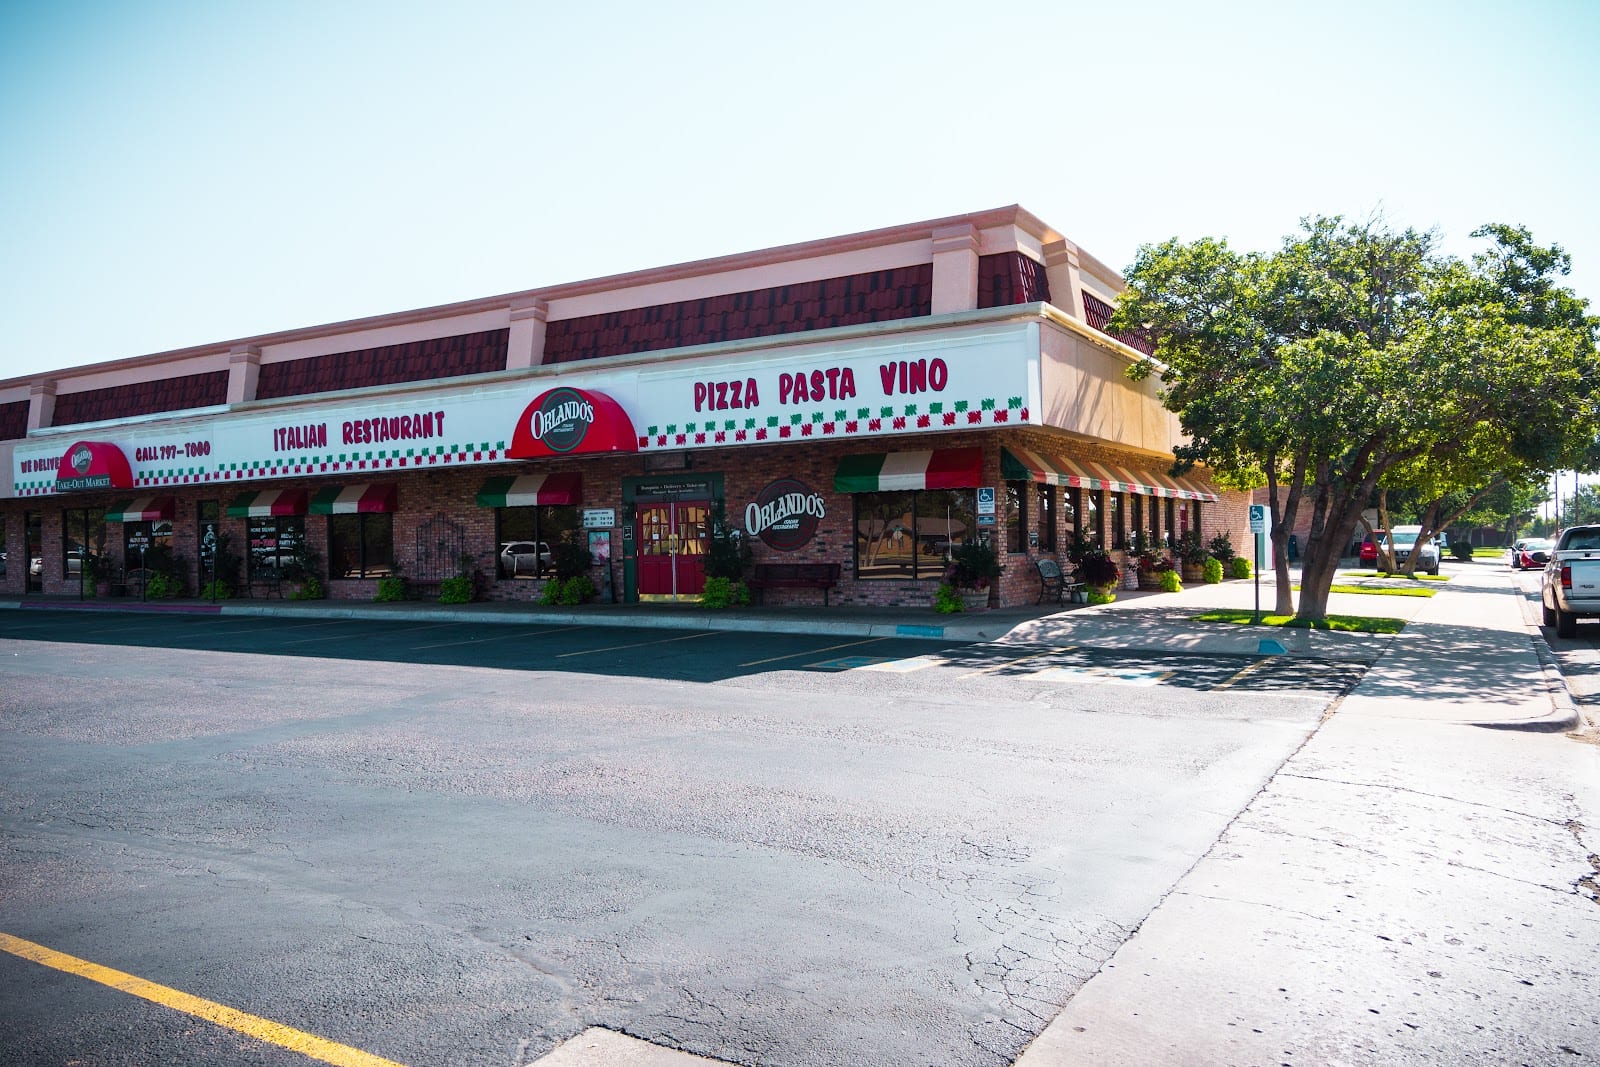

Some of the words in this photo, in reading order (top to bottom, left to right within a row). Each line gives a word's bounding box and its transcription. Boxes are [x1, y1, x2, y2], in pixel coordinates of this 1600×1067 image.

[694, 378, 759, 412] PIZZA
[779, 368, 856, 404] PASTA
[880, 358, 948, 396] VINO
[274, 423, 327, 451] ITALIAN
[342, 411, 445, 445] RESTAURANT
[530, 400, 594, 440] ORLANDO'S
[21, 459, 32, 474] WE
[136, 446, 159, 462] CALL
[86, 477, 110, 488] MARKET
[745, 492, 826, 536] ORLANDO'S
